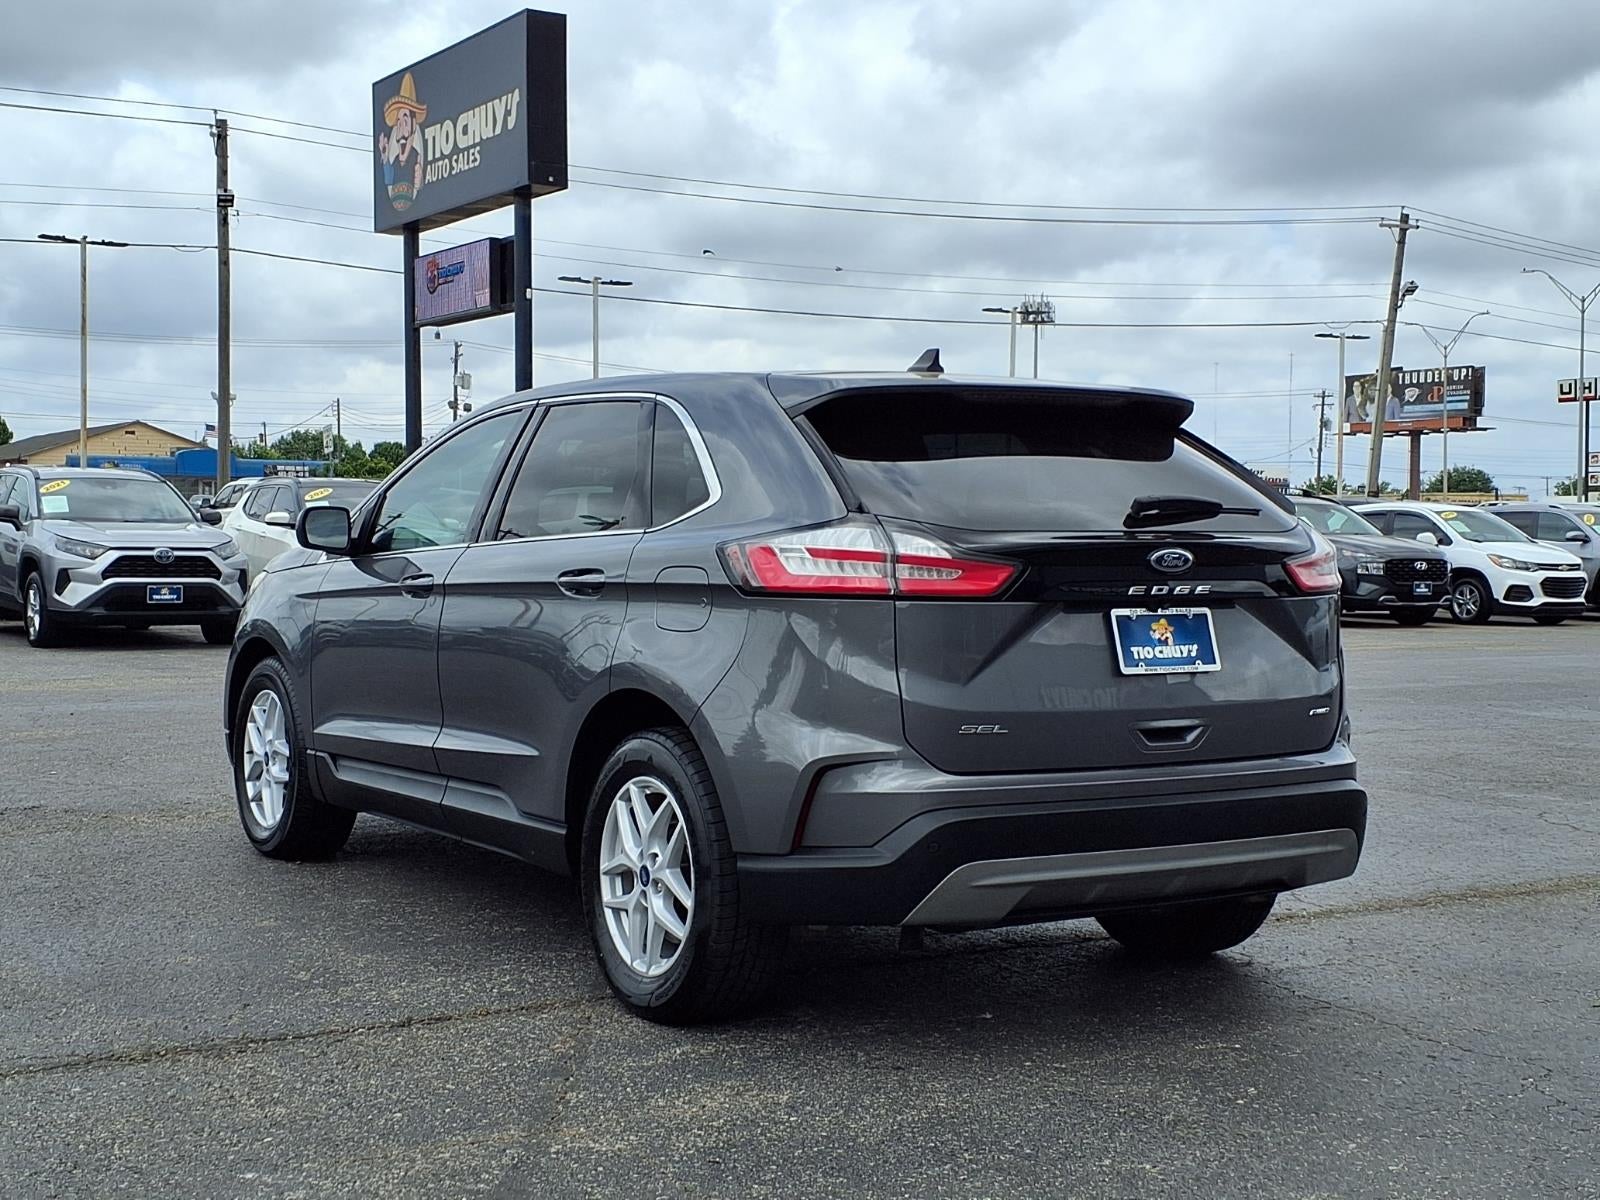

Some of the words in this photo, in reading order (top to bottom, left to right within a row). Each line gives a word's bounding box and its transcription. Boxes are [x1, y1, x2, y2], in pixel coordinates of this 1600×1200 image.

[424, 120, 454, 161] TIO
[456, 88, 520, 149] CHUY'S
[425, 160, 450, 184] AUTO
[451, 147, 480, 175] SALES
[1453, 368, 1473, 380] UP!
[1161, 554, 1185, 566] Ford
[1127, 585, 1212, 595] EDGE
[1130, 646, 1154, 659] TIO
[1154, 644, 1198, 658] CHUY'S
[958, 725, 1009, 734] SEL
